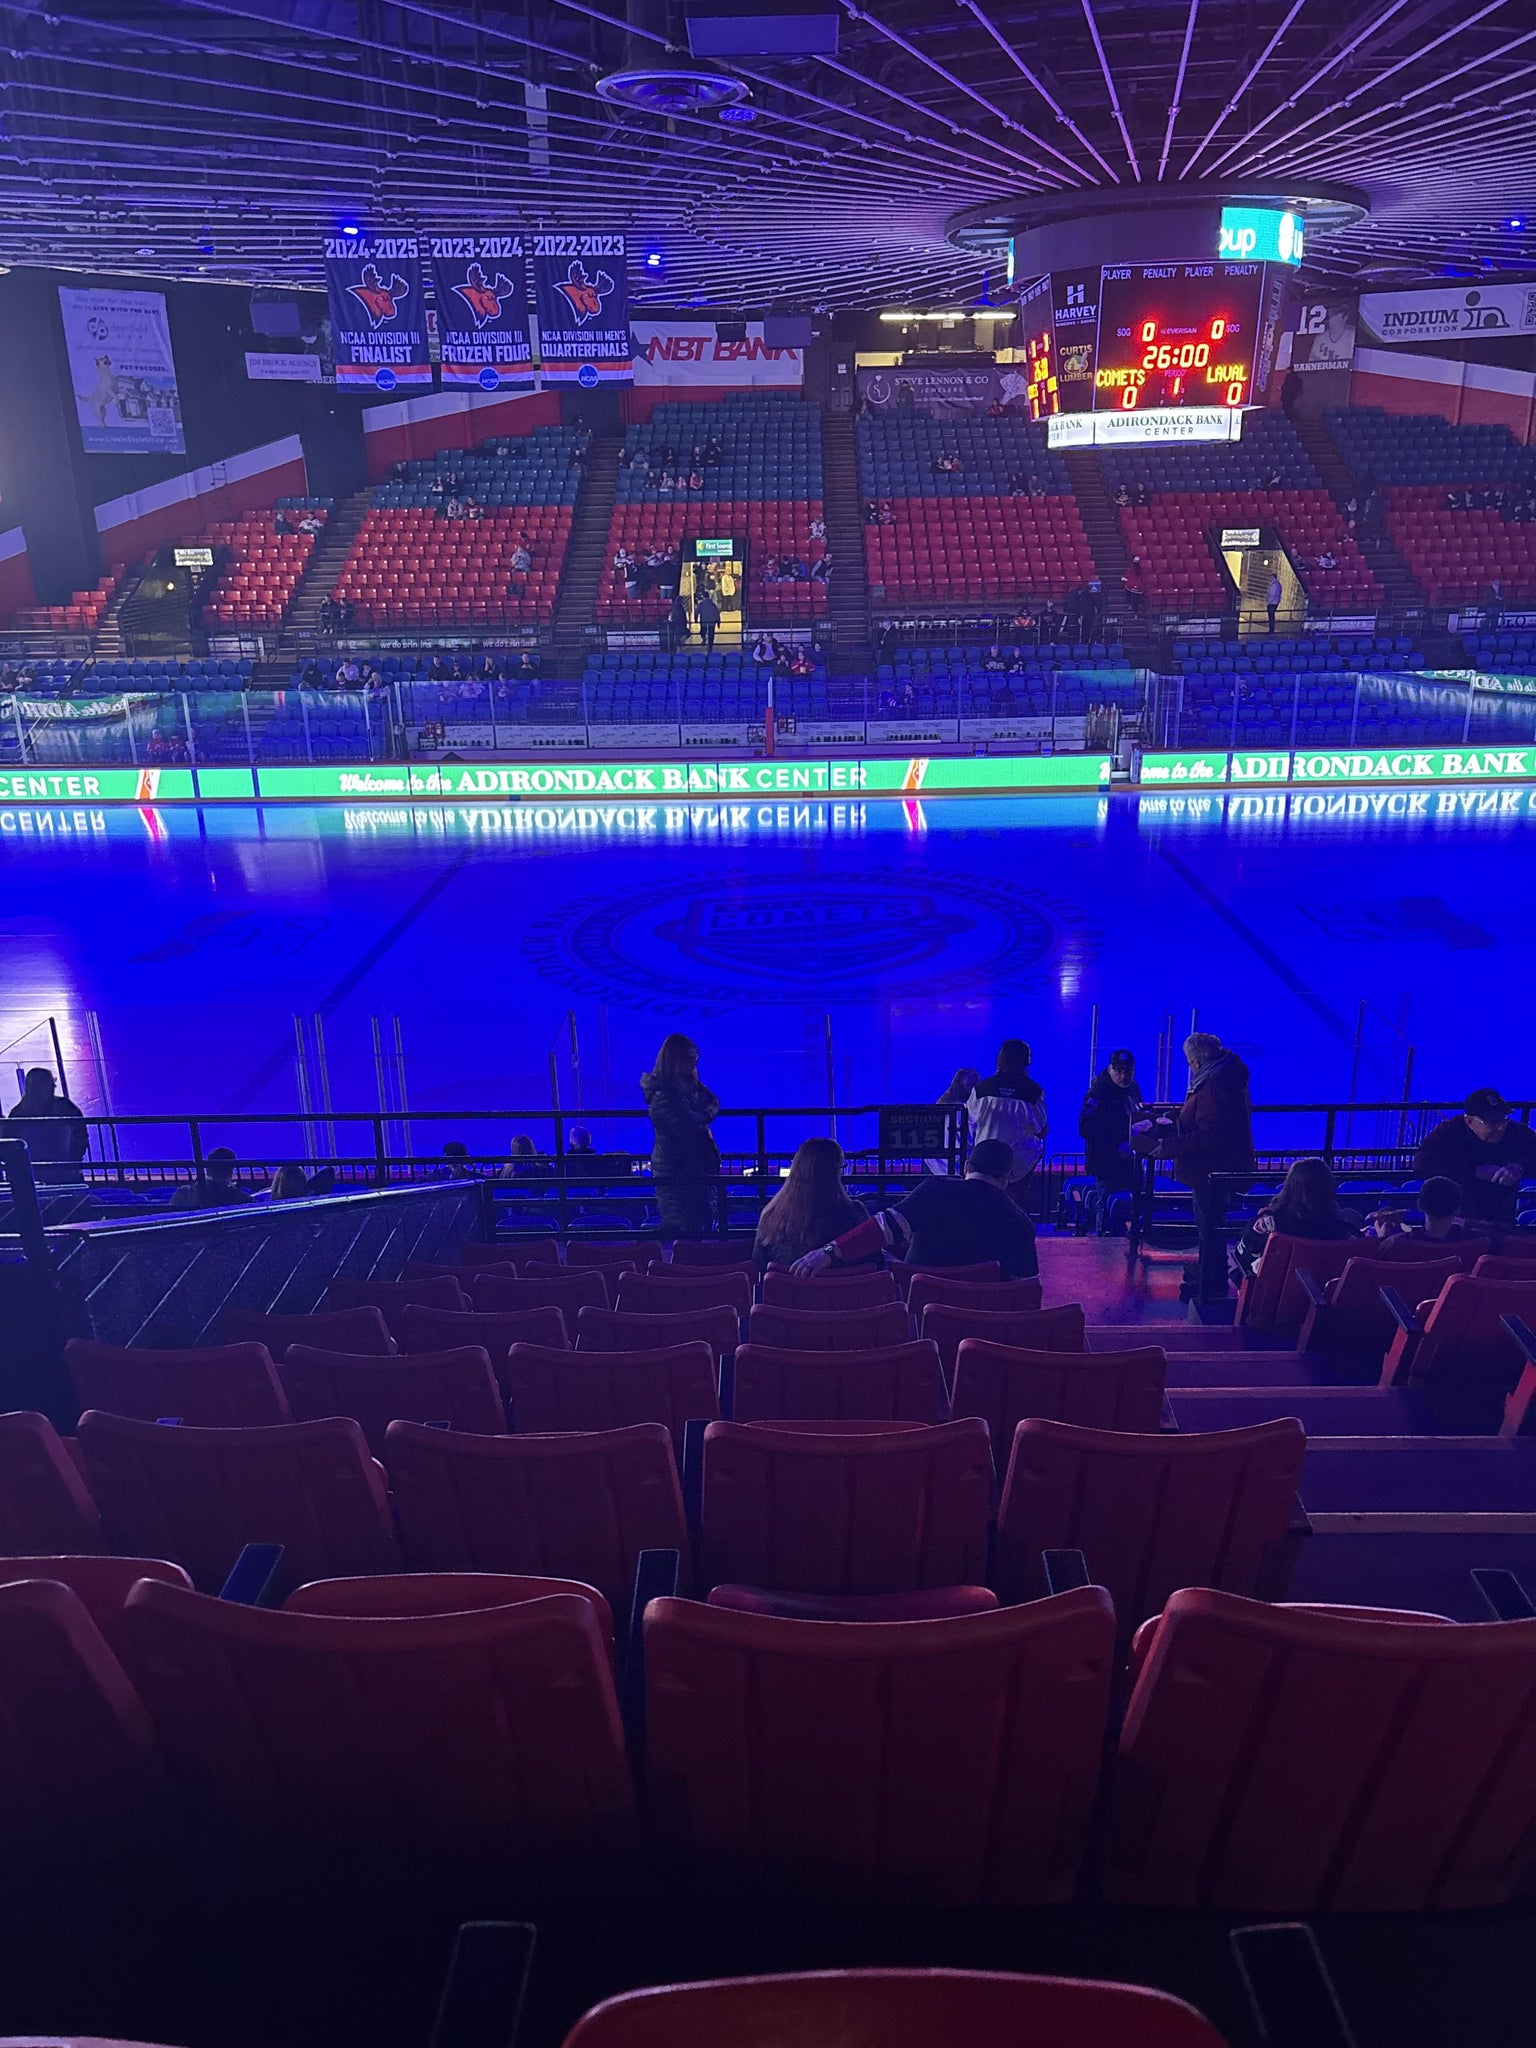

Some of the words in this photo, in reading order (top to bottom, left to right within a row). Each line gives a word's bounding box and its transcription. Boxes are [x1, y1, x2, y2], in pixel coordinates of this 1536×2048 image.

[324, 239, 419, 259] 2024-2025
[431, 237, 523, 258] 2023-2024
[533, 235, 625, 256] 2022-2023
[1103, 269, 1131, 280] PLAYER
[1143, 268, 1177, 279] PENALTY
[1185, 266, 1213, 277] PLAYER
[1225, 265, 1258, 275] PENALTY
[1055, 305, 1096, 321] HARVEY
[1296, 305, 1327, 335] 12
[1383, 309, 1459, 328] INDIUM
[340, 331, 366, 344] NCAA
[368, 331, 408, 345] DIVISION
[411, 331, 420, 344] III
[447, 331, 470, 345] NCAA
[472, 331, 512, 344] DIVISION
[514, 330, 522, 343] III
[542, 330, 561, 341] NCAA
[563, 330, 594, 341] DIVISION
[604, 330, 626, 341] MEN'S
[1117, 328, 1131, 337] SOG
[1142, 322, 1156, 342] 0
[1211, 319, 1225, 340] 0
[1226, 324, 1240, 333] SOG
[1382, 326, 1458, 336] CORPORATION
[351, 346, 412, 363] FINALIST
[442, 345, 492, 363] FROZEN
[496, 343, 530, 362] FOUR
[541, 342, 629, 357] QUARTERFINALS
[647, 336, 712, 361] NBT
[1060, 344, 1093, 356] CURTIS
[1143, 344, 1209, 369] 26:00
[1206, 365, 1247, 383] LAVAL
[1293, 360, 1349, 372] BANNERMAN
[925, 376, 963, 385] LENNON
[975, 376, 989, 384] CO
[1060, 371, 1093, 383] LUMBER
[1096, 369, 1145, 387] COMETS
[1122, 386, 1138, 409] 0
[1226, 382, 1242, 406] 0
[1060, 418, 1083, 429] BANK
[1107, 415, 1193, 428] ADIRONDACK
[1196, 414, 1223, 425] BANK
[1144, 427, 1194, 436] CENTER
[1171, 761, 1189, 779] to
[1189, 760, 1215, 779] the
[1217, 754, 1435, 779] ADIRONDACK
[1441, 752, 1529, 775] BANK
[0, 776, 100, 797] CENTER
[339, 773, 402, 792] Welcome
[406, 774, 425, 792] to
[426, 772, 453, 792] the
[456, 769, 656, 791] ADIRONDACK
[663, 767, 750, 790] BANK
[756, 767, 867, 788] CENTER
[711, 902, 912, 928] COMETS
[889, 1114, 943, 1124] SECTION
[889, 1129, 939, 1149] 115
